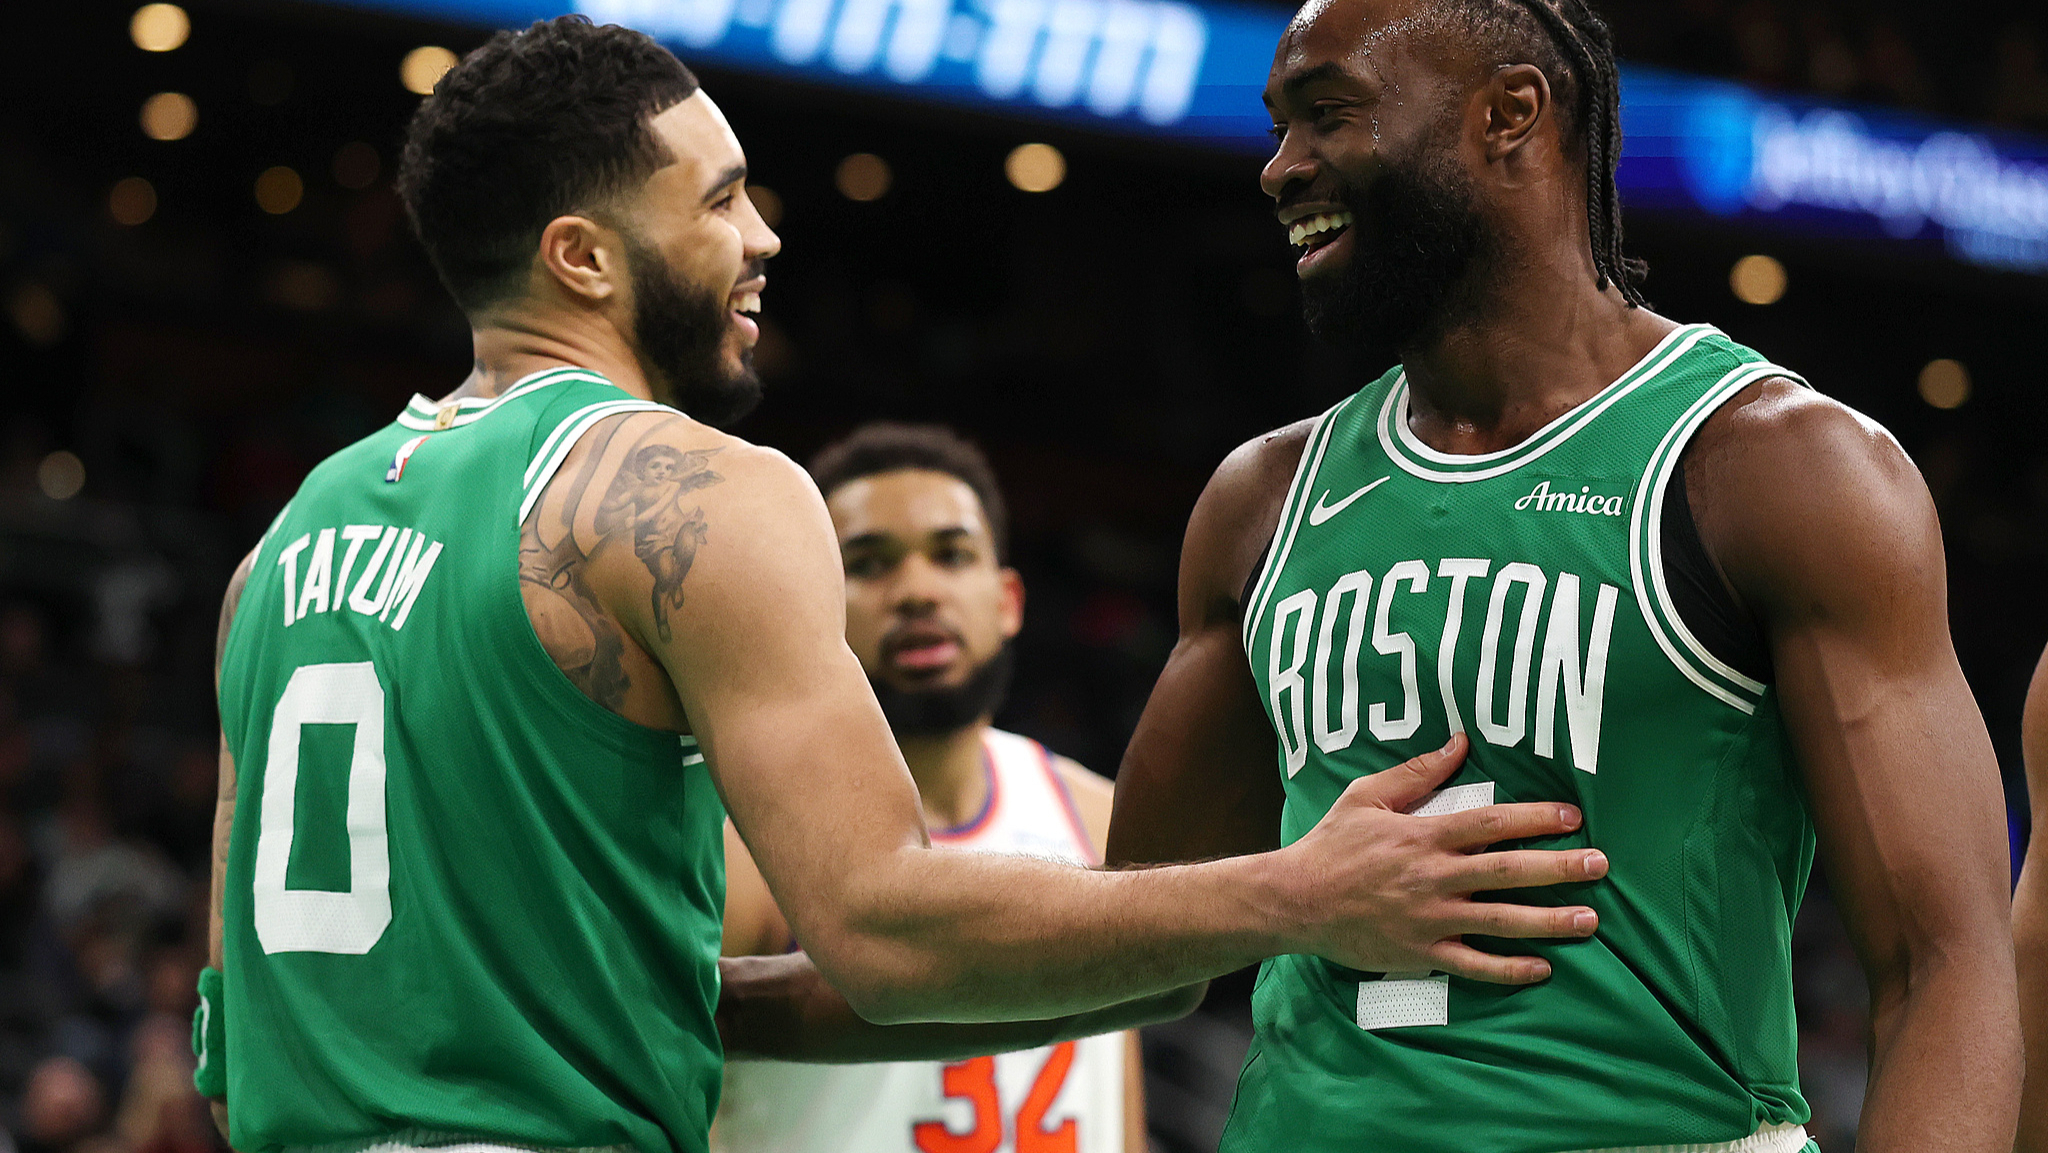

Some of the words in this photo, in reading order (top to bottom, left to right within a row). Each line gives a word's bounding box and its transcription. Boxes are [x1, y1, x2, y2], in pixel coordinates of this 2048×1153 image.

[277, 525, 444, 631] TATUM
[1514, 480, 1624, 516] Amica
[1269, 558, 1619, 780] BOSTON
[253, 661, 393, 955] 0
